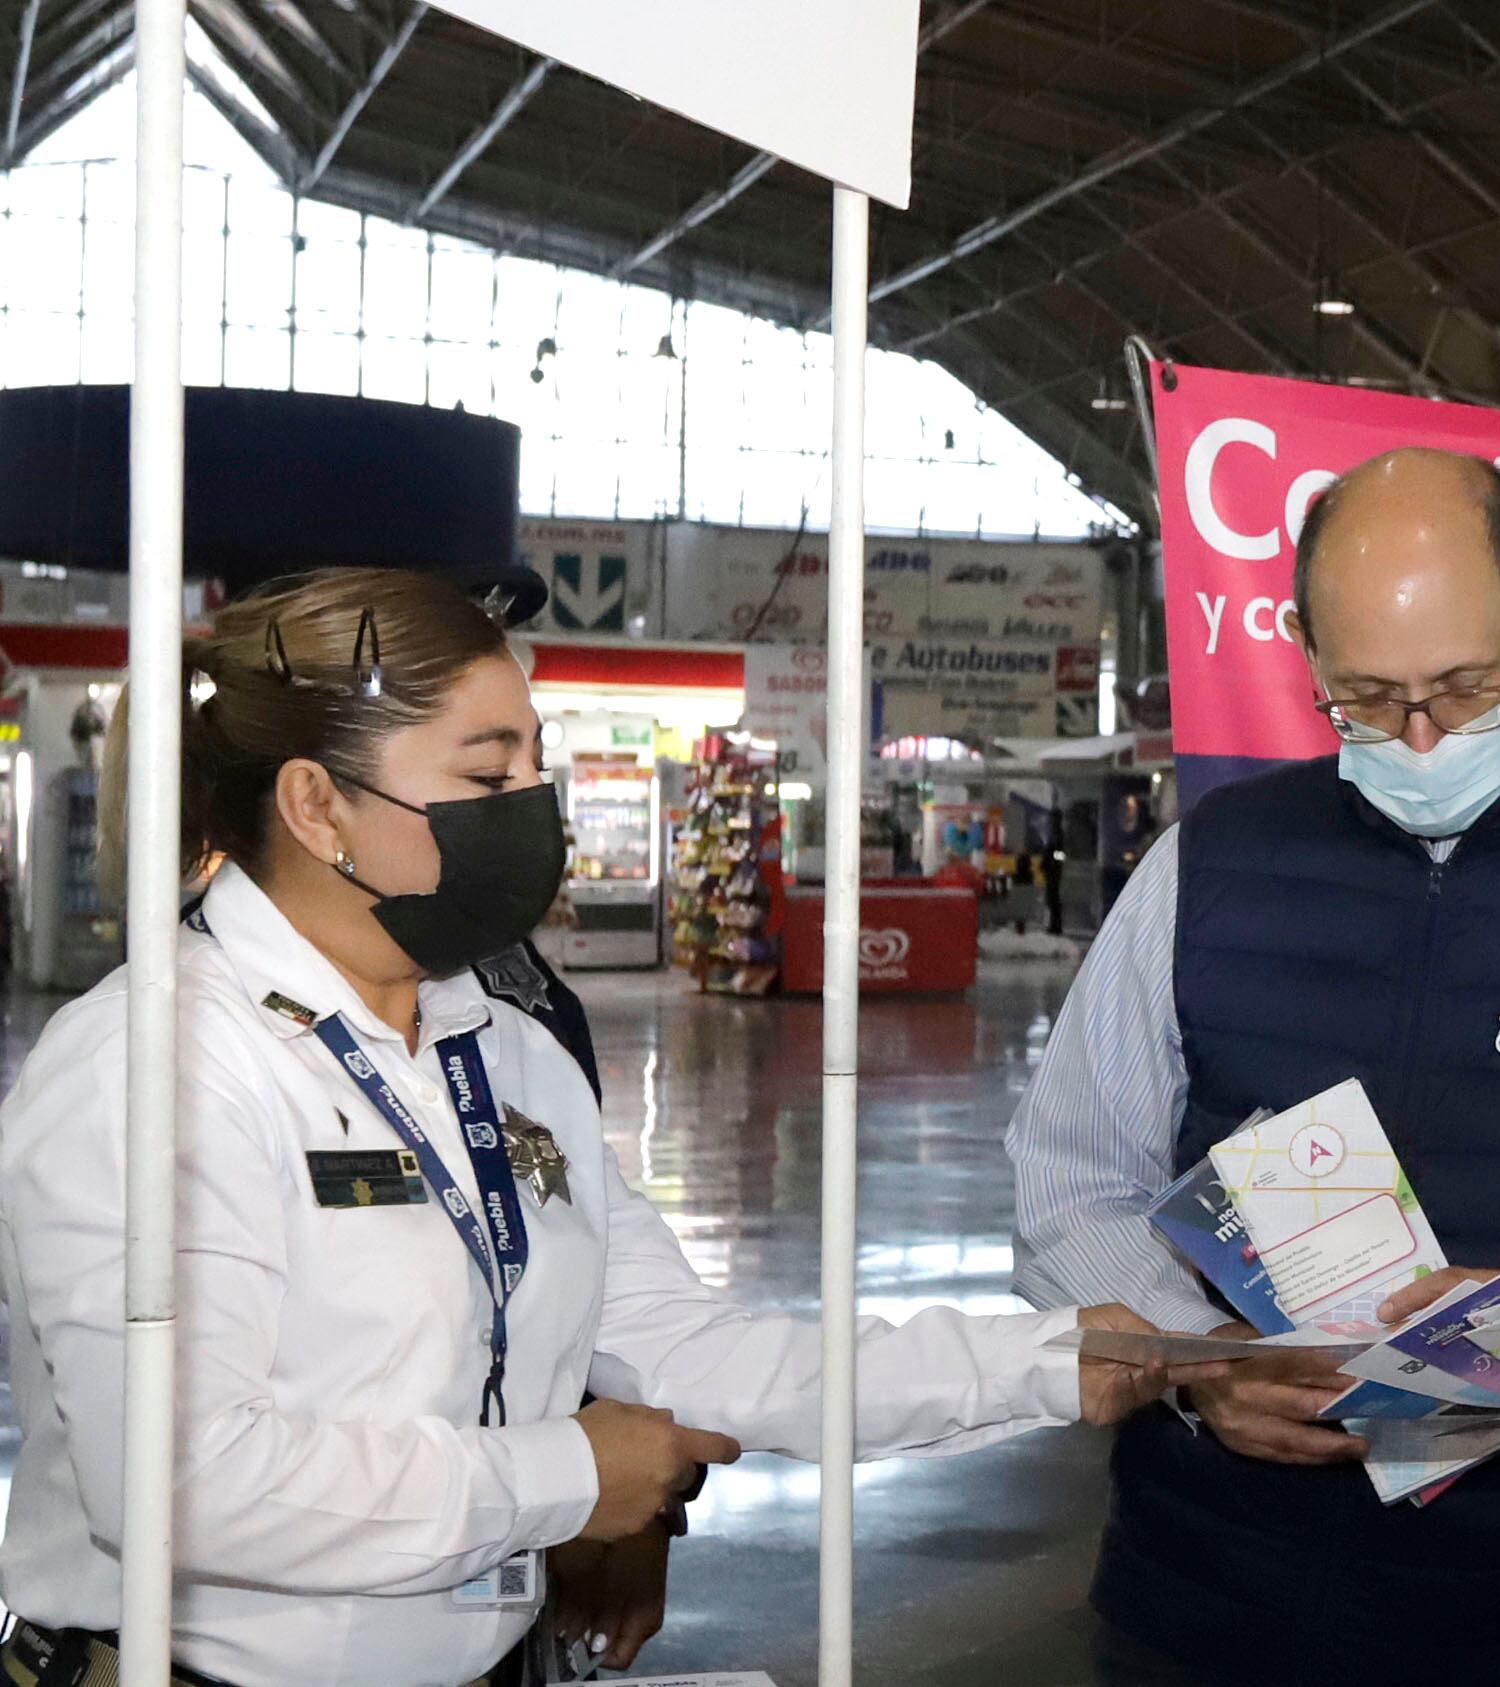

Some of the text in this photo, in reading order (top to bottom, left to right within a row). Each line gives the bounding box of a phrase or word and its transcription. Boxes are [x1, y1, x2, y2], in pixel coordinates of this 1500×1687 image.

[1196, 593, 1226, 655] y
[449, 1055, 475, 1113] Puebla
[379, 1085, 426, 1144] Puebla
[488, 1191, 513, 1252] Puebla
